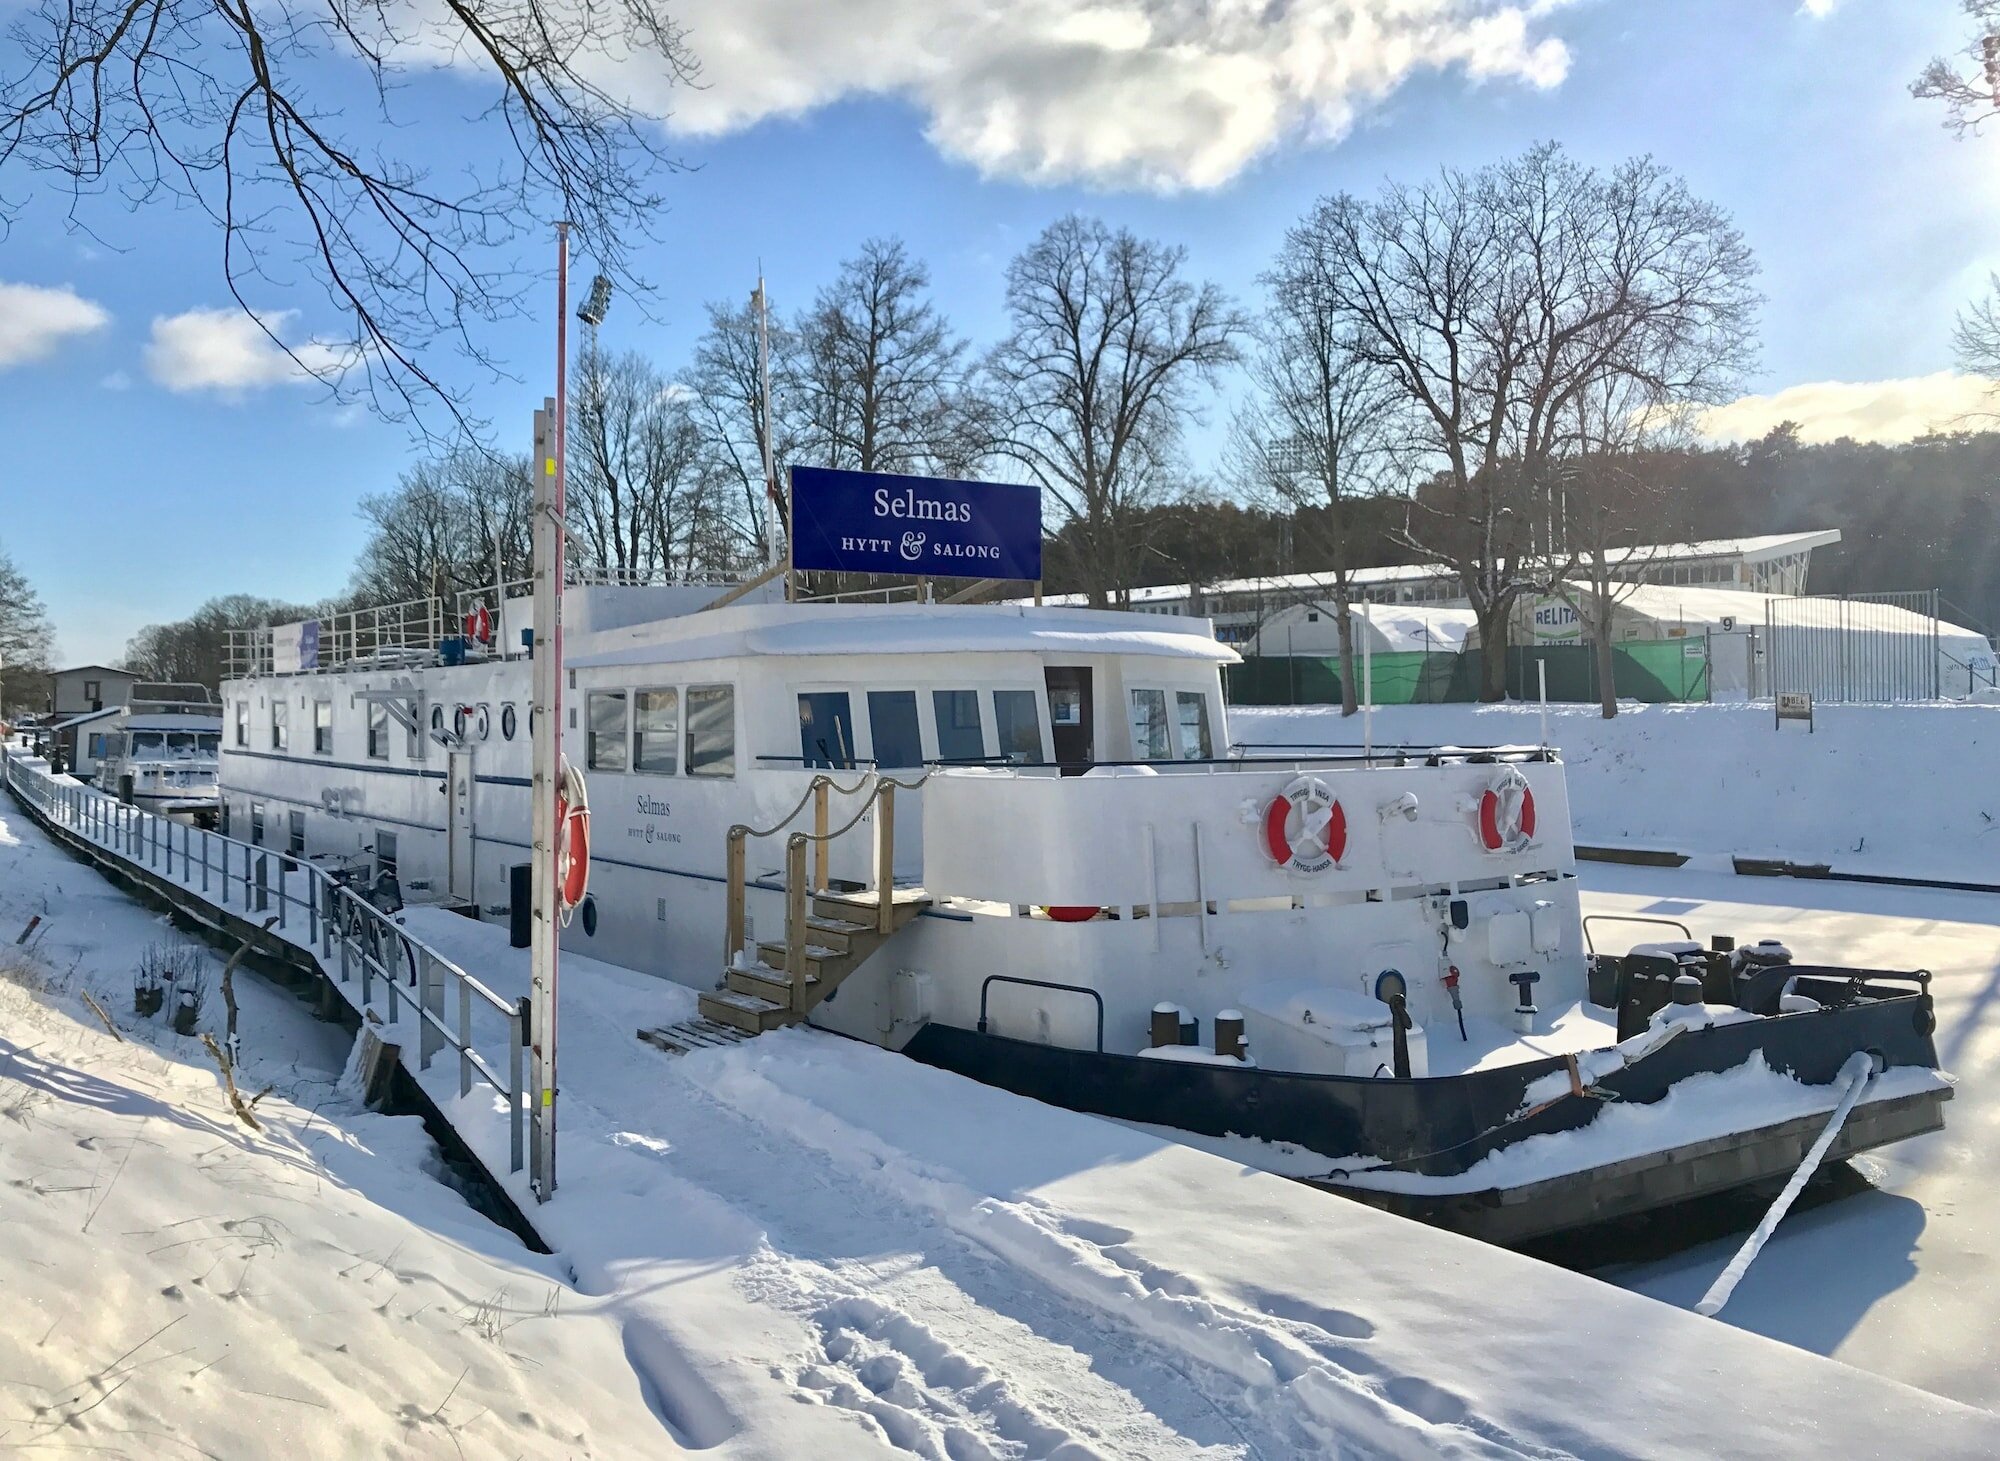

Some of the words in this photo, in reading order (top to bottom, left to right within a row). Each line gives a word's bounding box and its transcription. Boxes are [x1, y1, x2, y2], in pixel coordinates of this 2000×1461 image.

[873, 488, 971, 523] Selmas
[841, 536, 892, 553] HYTT
[900, 531, 926, 561] &
[933, 542, 1001, 560] SALONG
[1723, 616, 1733, 632] 9
[637, 794, 671, 817] Selmas
[656, 831, 681, 844] SALONG
[1292, 858, 1332, 873] TRYGG-HANSA
